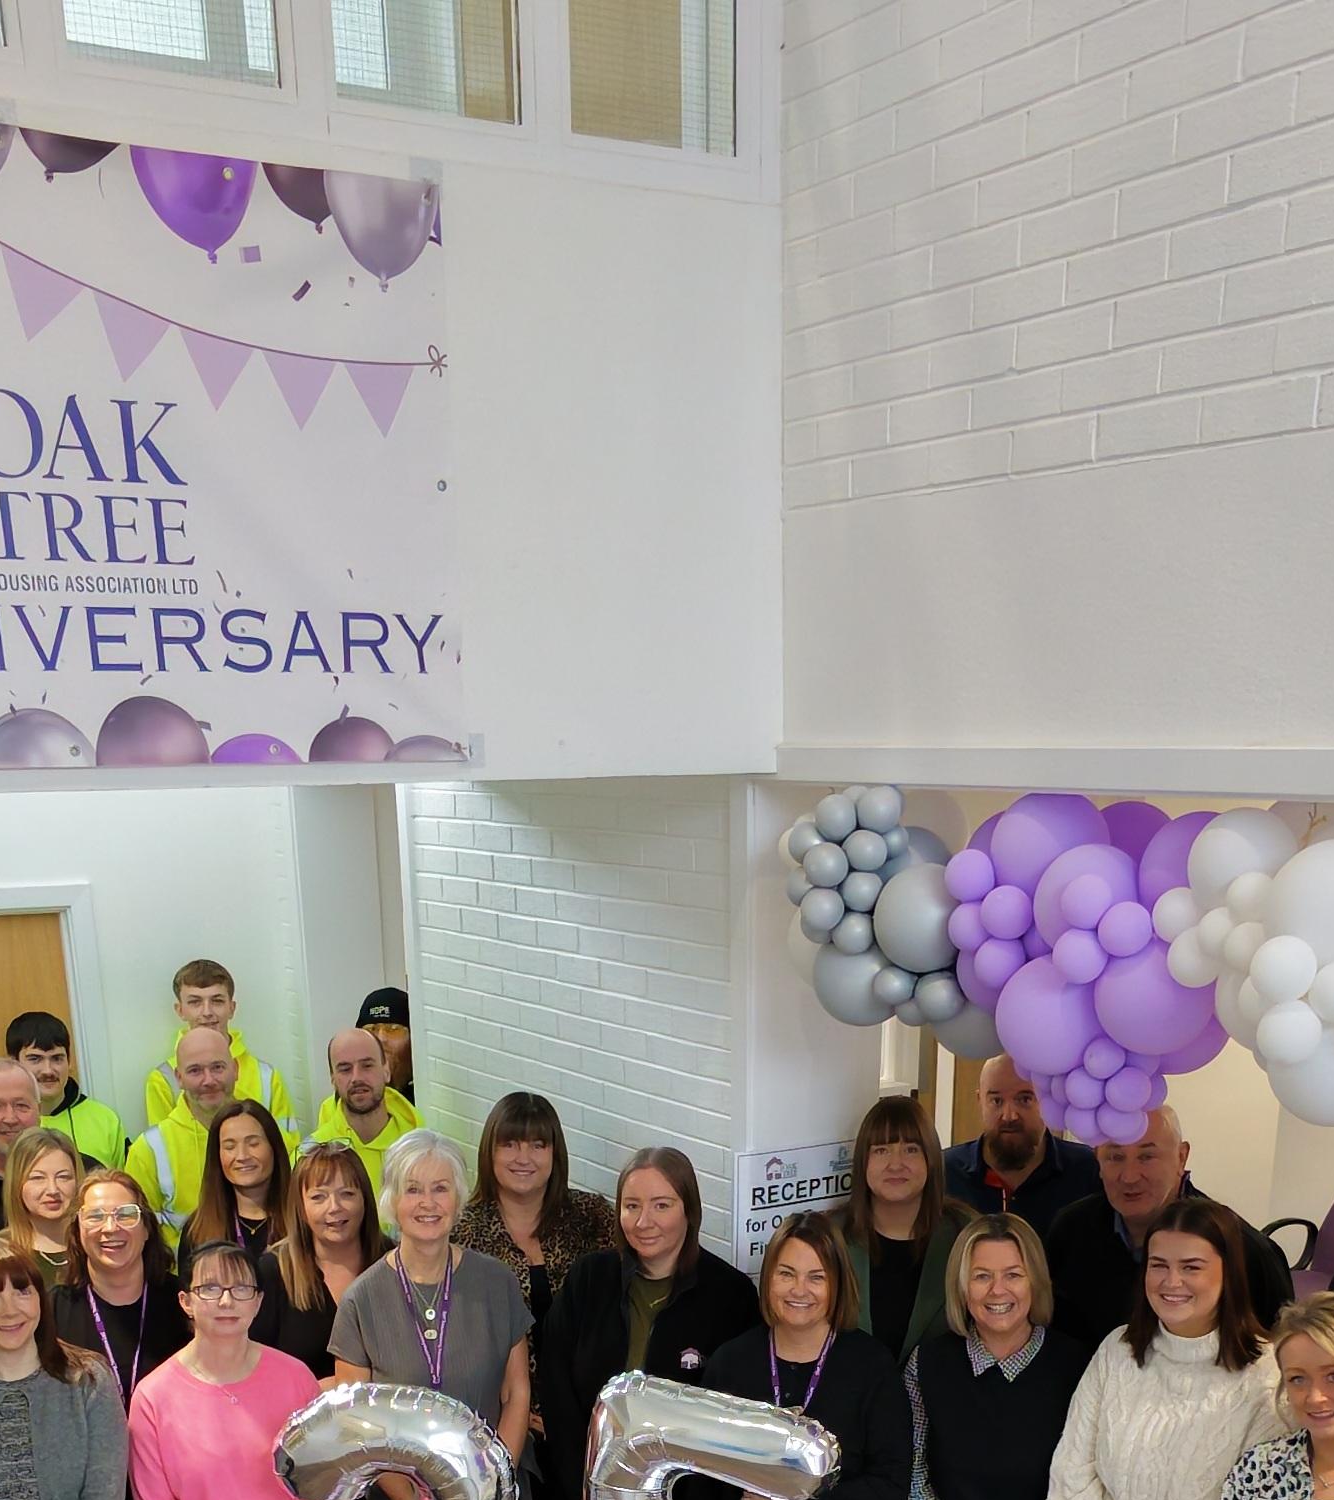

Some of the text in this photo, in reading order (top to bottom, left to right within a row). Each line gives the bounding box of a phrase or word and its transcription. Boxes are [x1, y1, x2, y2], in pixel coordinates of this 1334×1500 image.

[65, 575, 167, 595] ASSOCIATION
[172, 578, 199, 595] LTD
[752, 1173, 852, 1206] RECEPTIO
[746, 1219, 767, 1233] for
